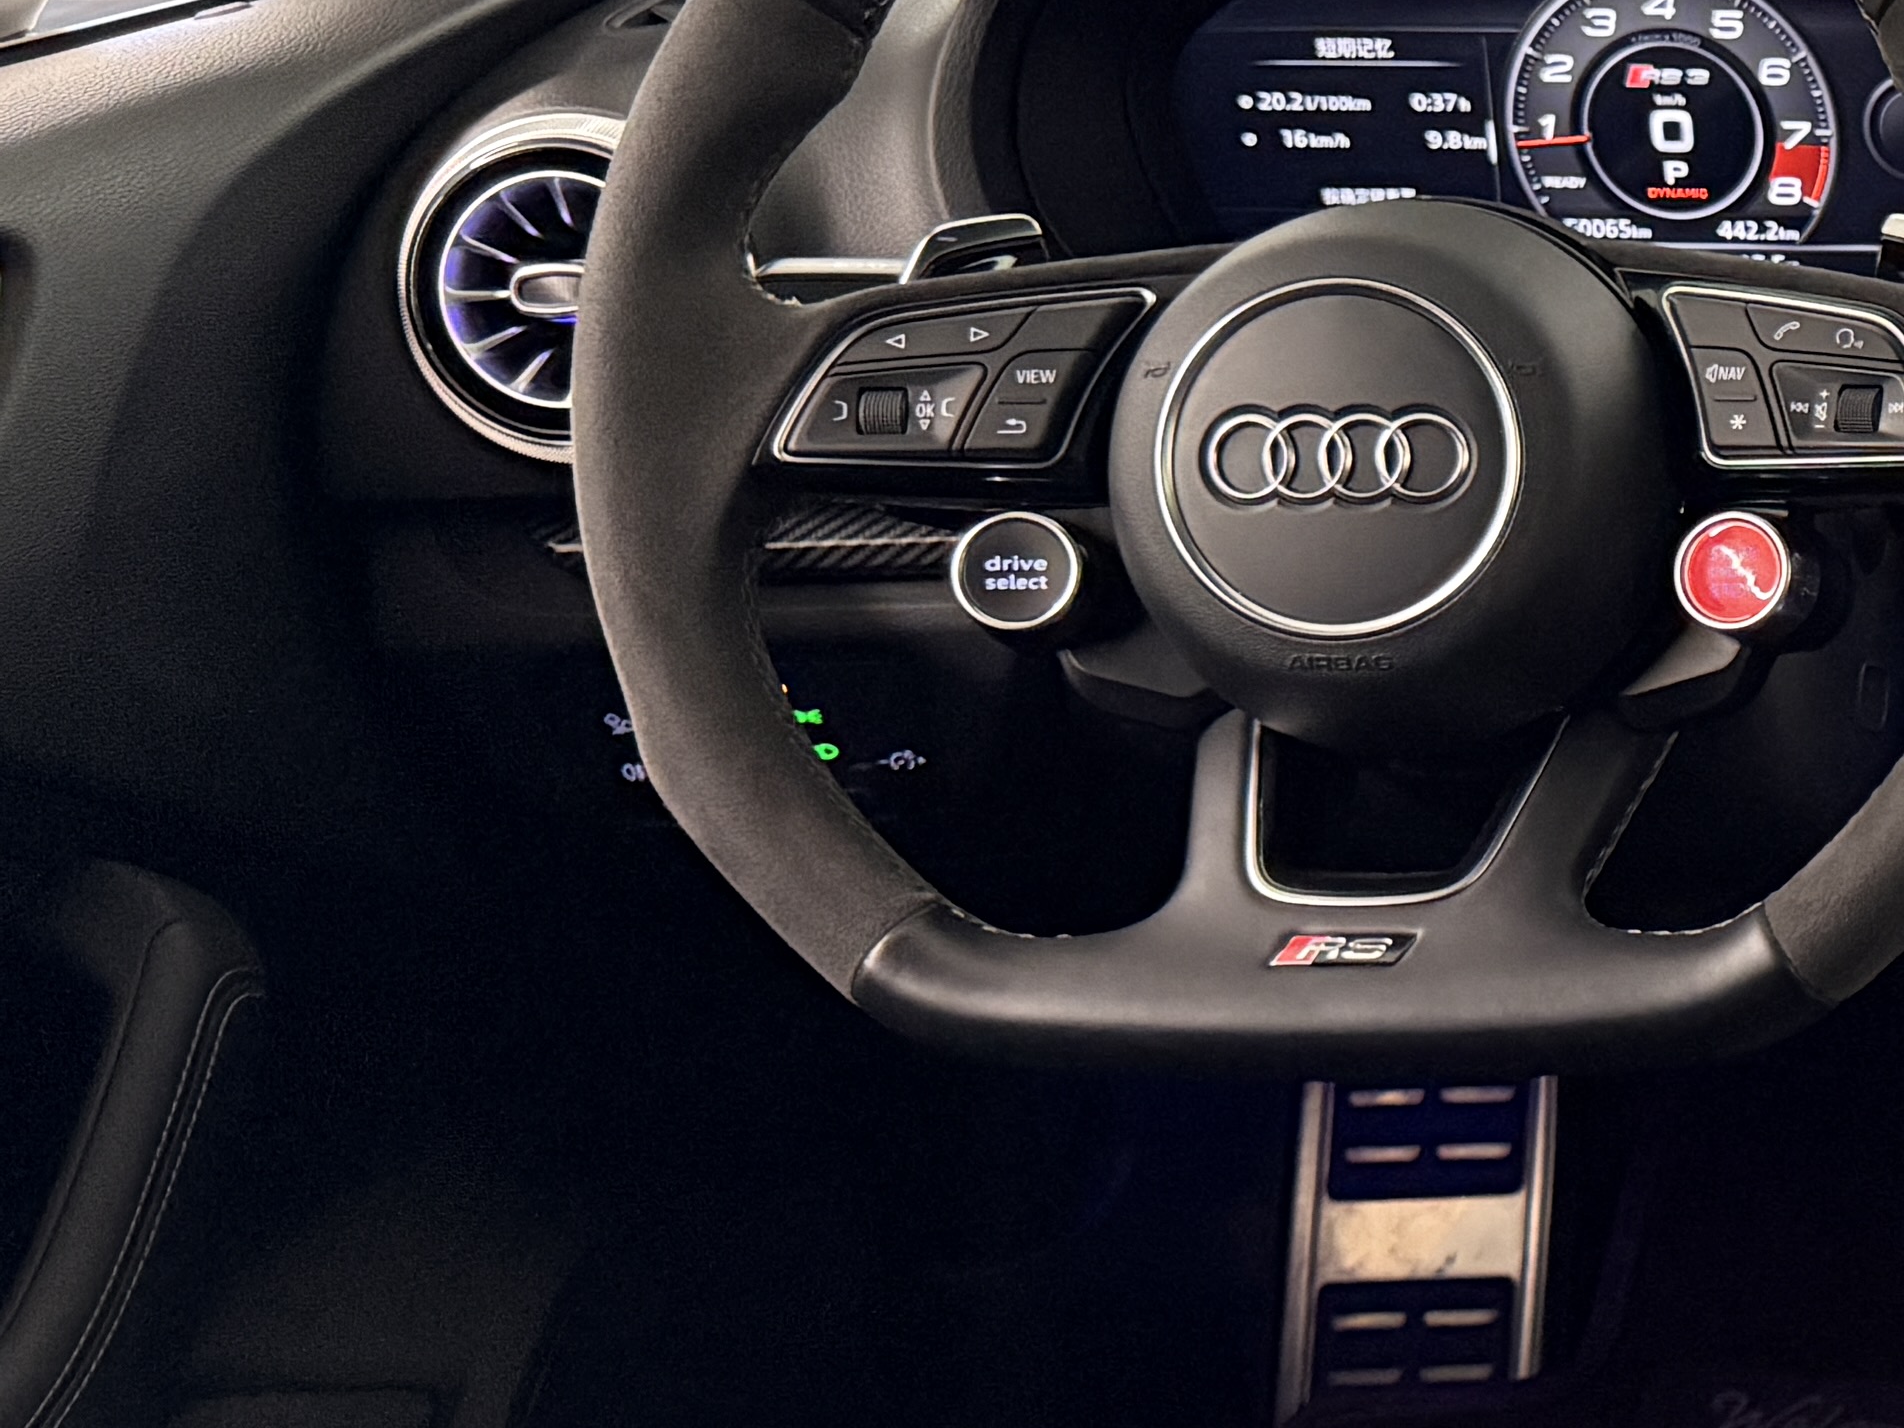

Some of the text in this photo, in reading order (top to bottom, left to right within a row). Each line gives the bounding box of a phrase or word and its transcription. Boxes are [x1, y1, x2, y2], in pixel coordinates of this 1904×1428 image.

[1580, 7, 1617, 38] 3
[1708, 9, 1745, 40] 5
[1313, 37, 1396, 59] 短期记忆
[1539, 53, 1575, 84] 2
[1757, 56, 1792, 87] 6
[1537, 113, 1558, 140] 1
[1649, 109, 1695, 153] 0
[1779, 120, 1812, 150] 7
[1662, 160, 1689, 185] P
[1766, 176, 1802, 206] 8
[1015, 368, 1057, 385] VIEW
[1718, 363, 1746, 382] NAV
[915, 402, 936, 420] OK
[984, 554, 1049, 572] drive
[984, 573, 1049, 591] select
[1287, 653, 1396, 673] AIRBAG
